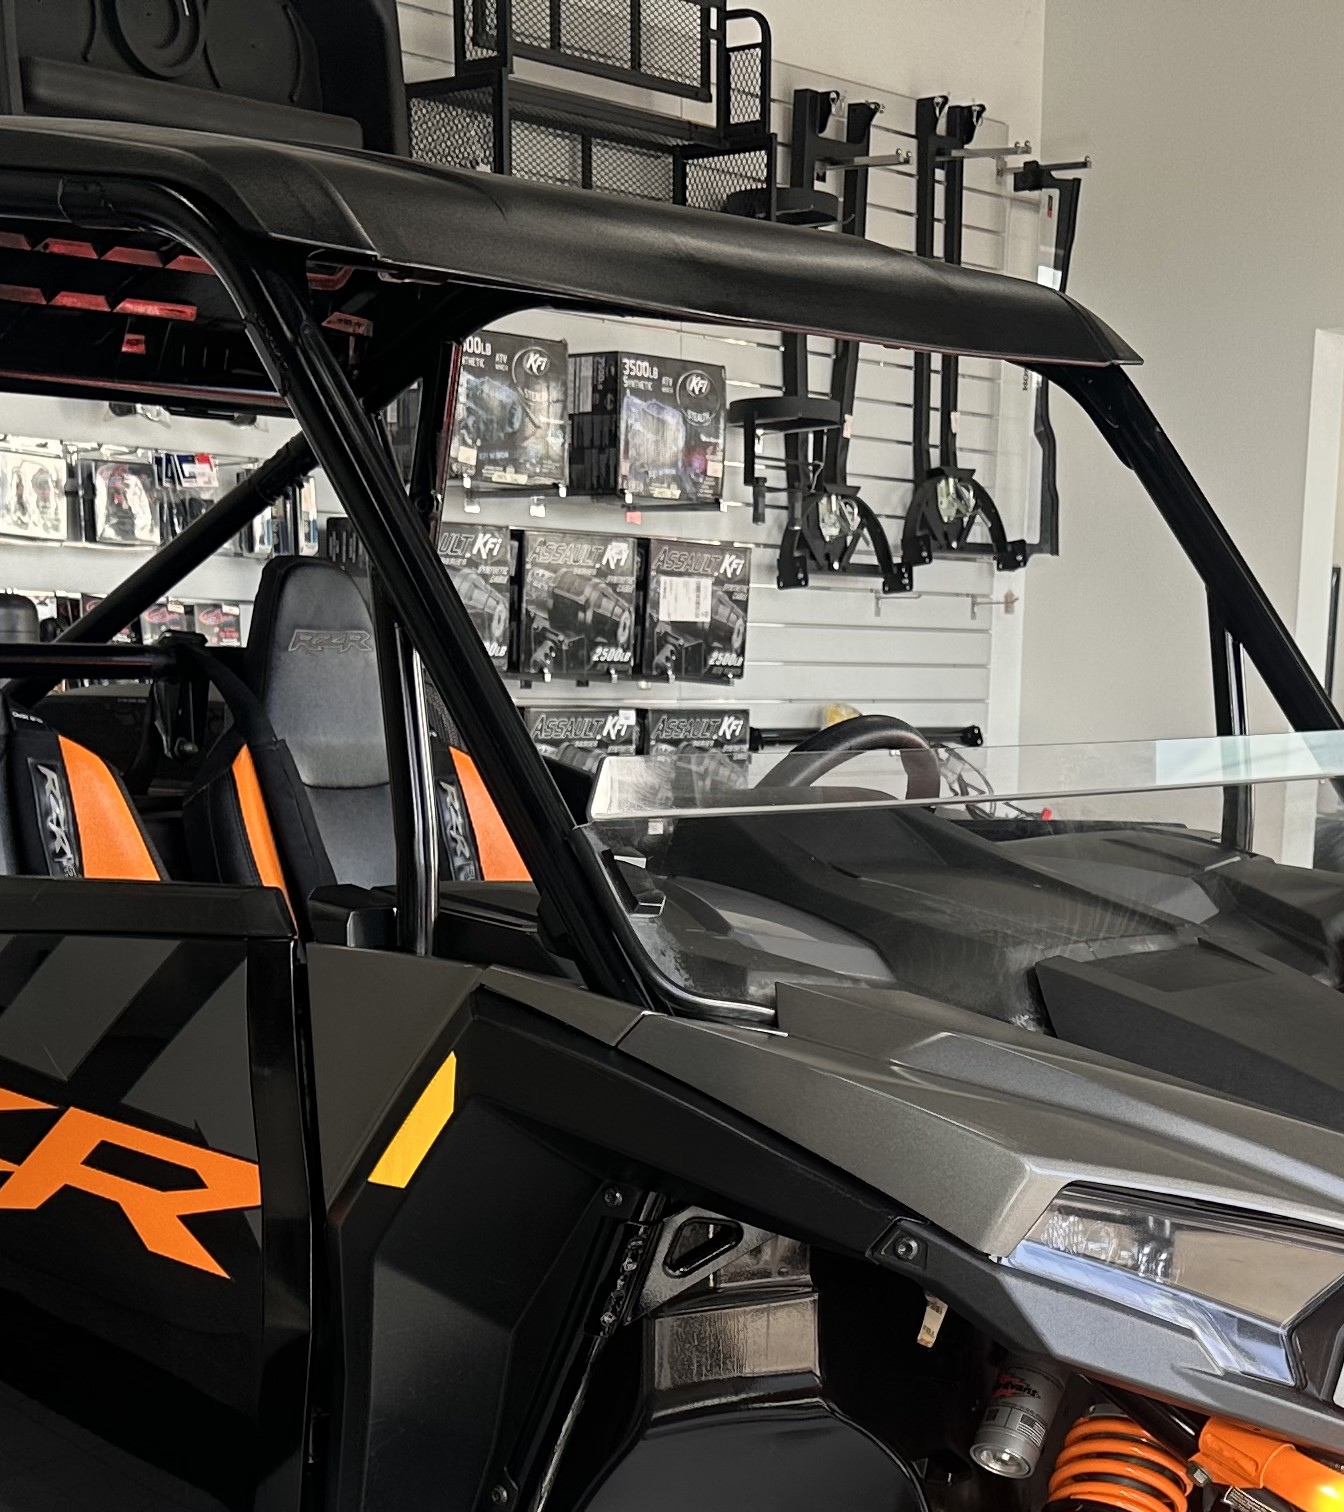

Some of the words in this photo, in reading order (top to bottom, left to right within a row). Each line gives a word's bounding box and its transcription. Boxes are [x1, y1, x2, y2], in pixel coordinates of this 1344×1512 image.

[622, 358, 659, 379] 3500LB
[526, 537, 604, 567] ASSAULT
[651, 545, 722, 575] ASSAULT
[593, 645, 631, 662] 2500LB
[709, 650, 743, 667] 2500LB
[530, 713, 604, 740] ASSAULT
[650, 714, 722, 740] ASSAULT
